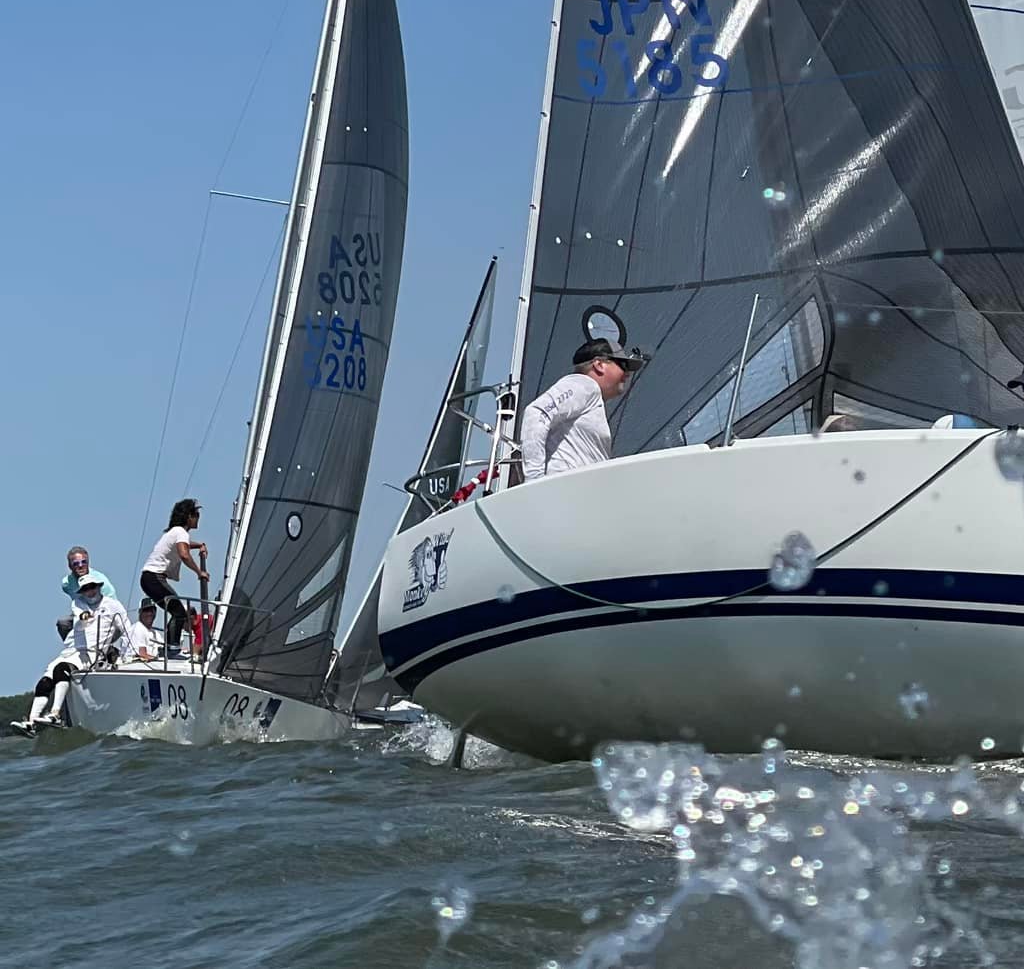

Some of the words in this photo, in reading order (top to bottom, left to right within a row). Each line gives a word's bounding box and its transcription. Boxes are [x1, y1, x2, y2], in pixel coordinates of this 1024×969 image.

[576, 33, 729, 98] 5185
[306, 312, 366, 355] USA
[303, 350, 367, 392] 5208
[429, 476, 450, 496] USA
